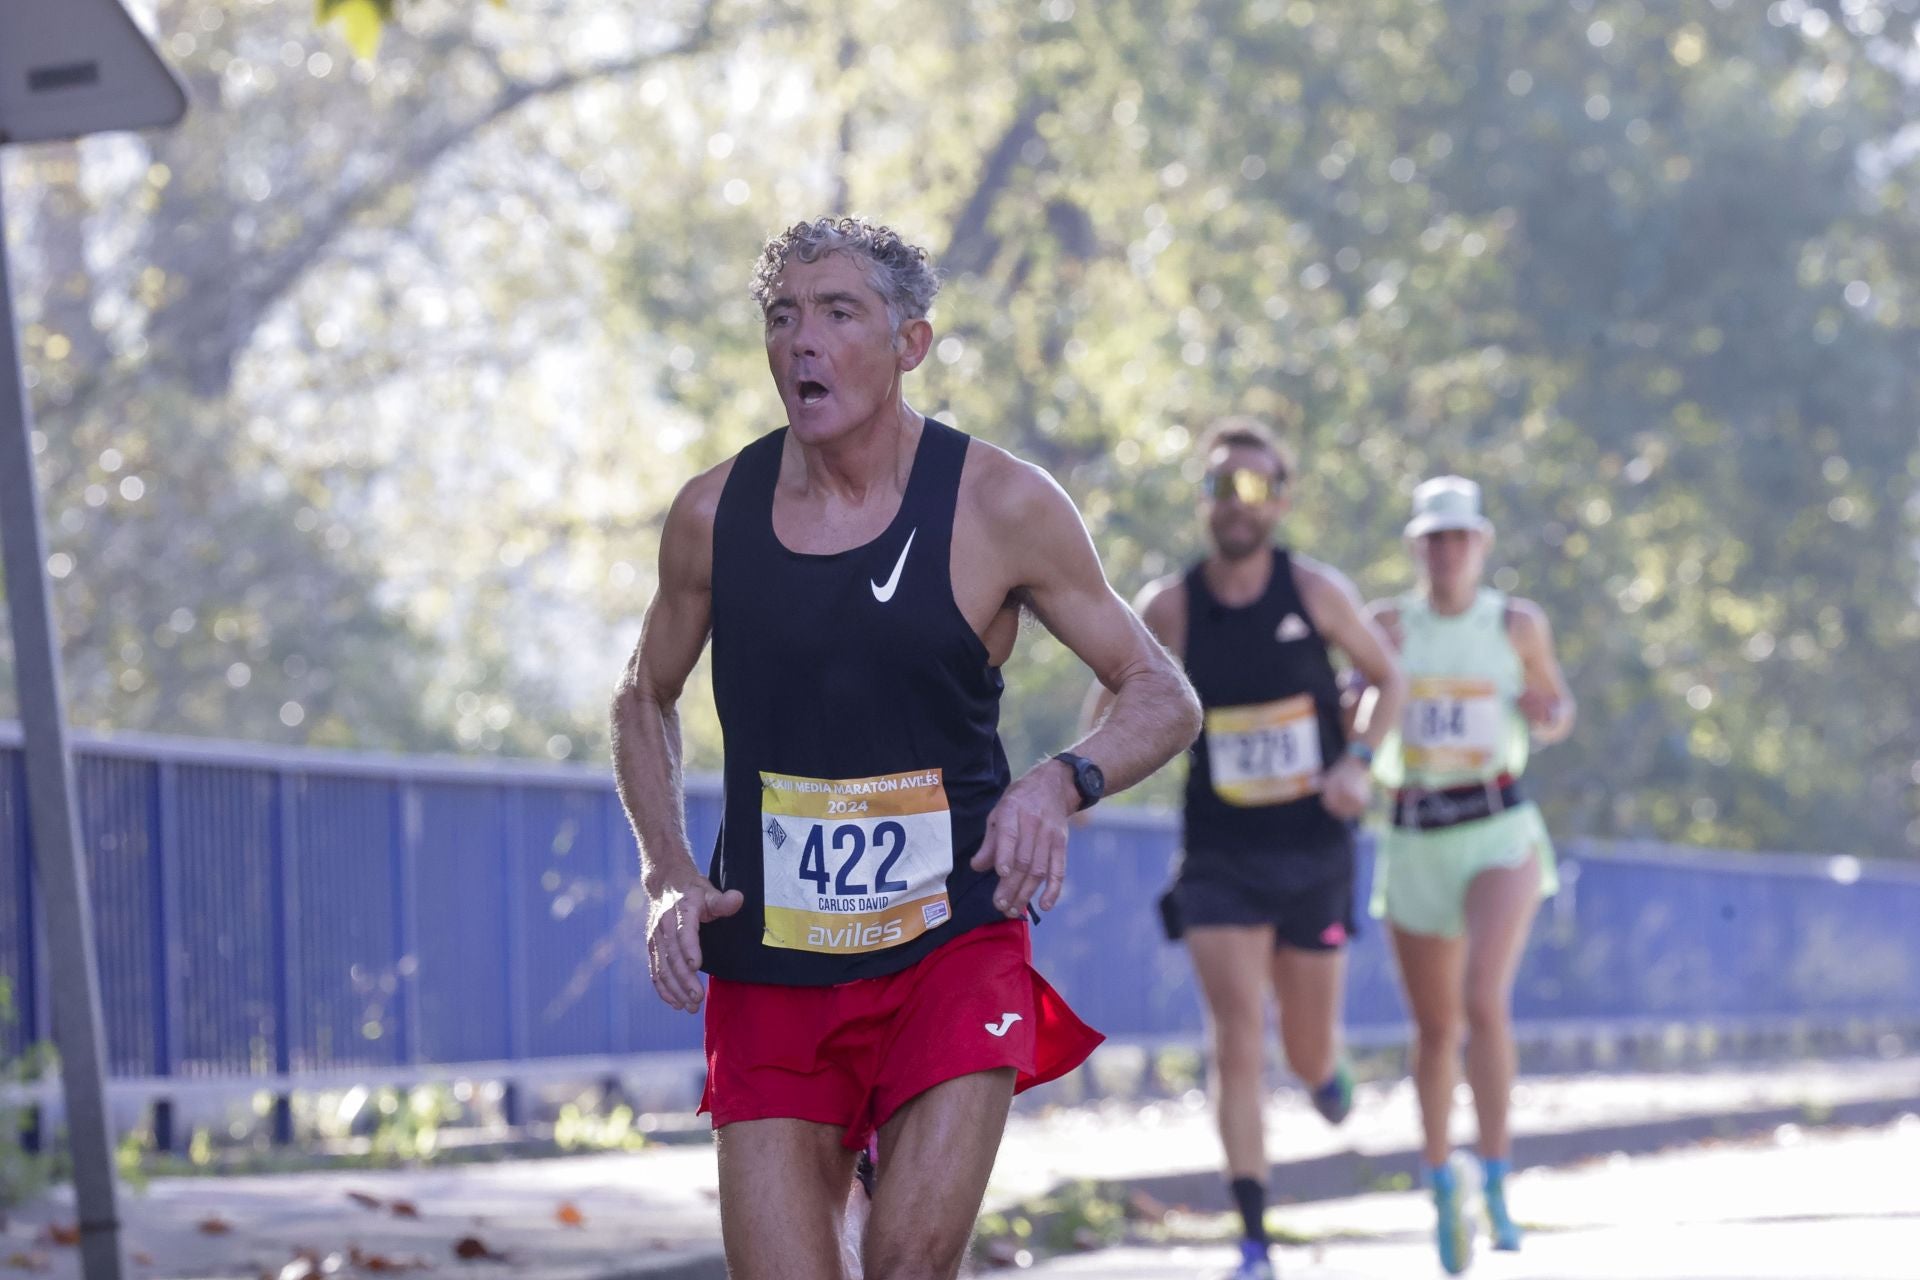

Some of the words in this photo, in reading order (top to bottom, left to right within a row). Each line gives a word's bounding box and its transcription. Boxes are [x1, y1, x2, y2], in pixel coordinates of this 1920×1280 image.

[796, 781, 831, 793] MEDIA
[834, 778, 898, 795] MARATÓN
[900, 771, 939, 789] AVILÉS
[828, 800, 869, 814] 2024
[799, 821, 908, 895] 422
[818, 897, 855, 911] CARLOS
[859, 896, 889, 911] DAVID
[807, 918, 903, 948] avilés
